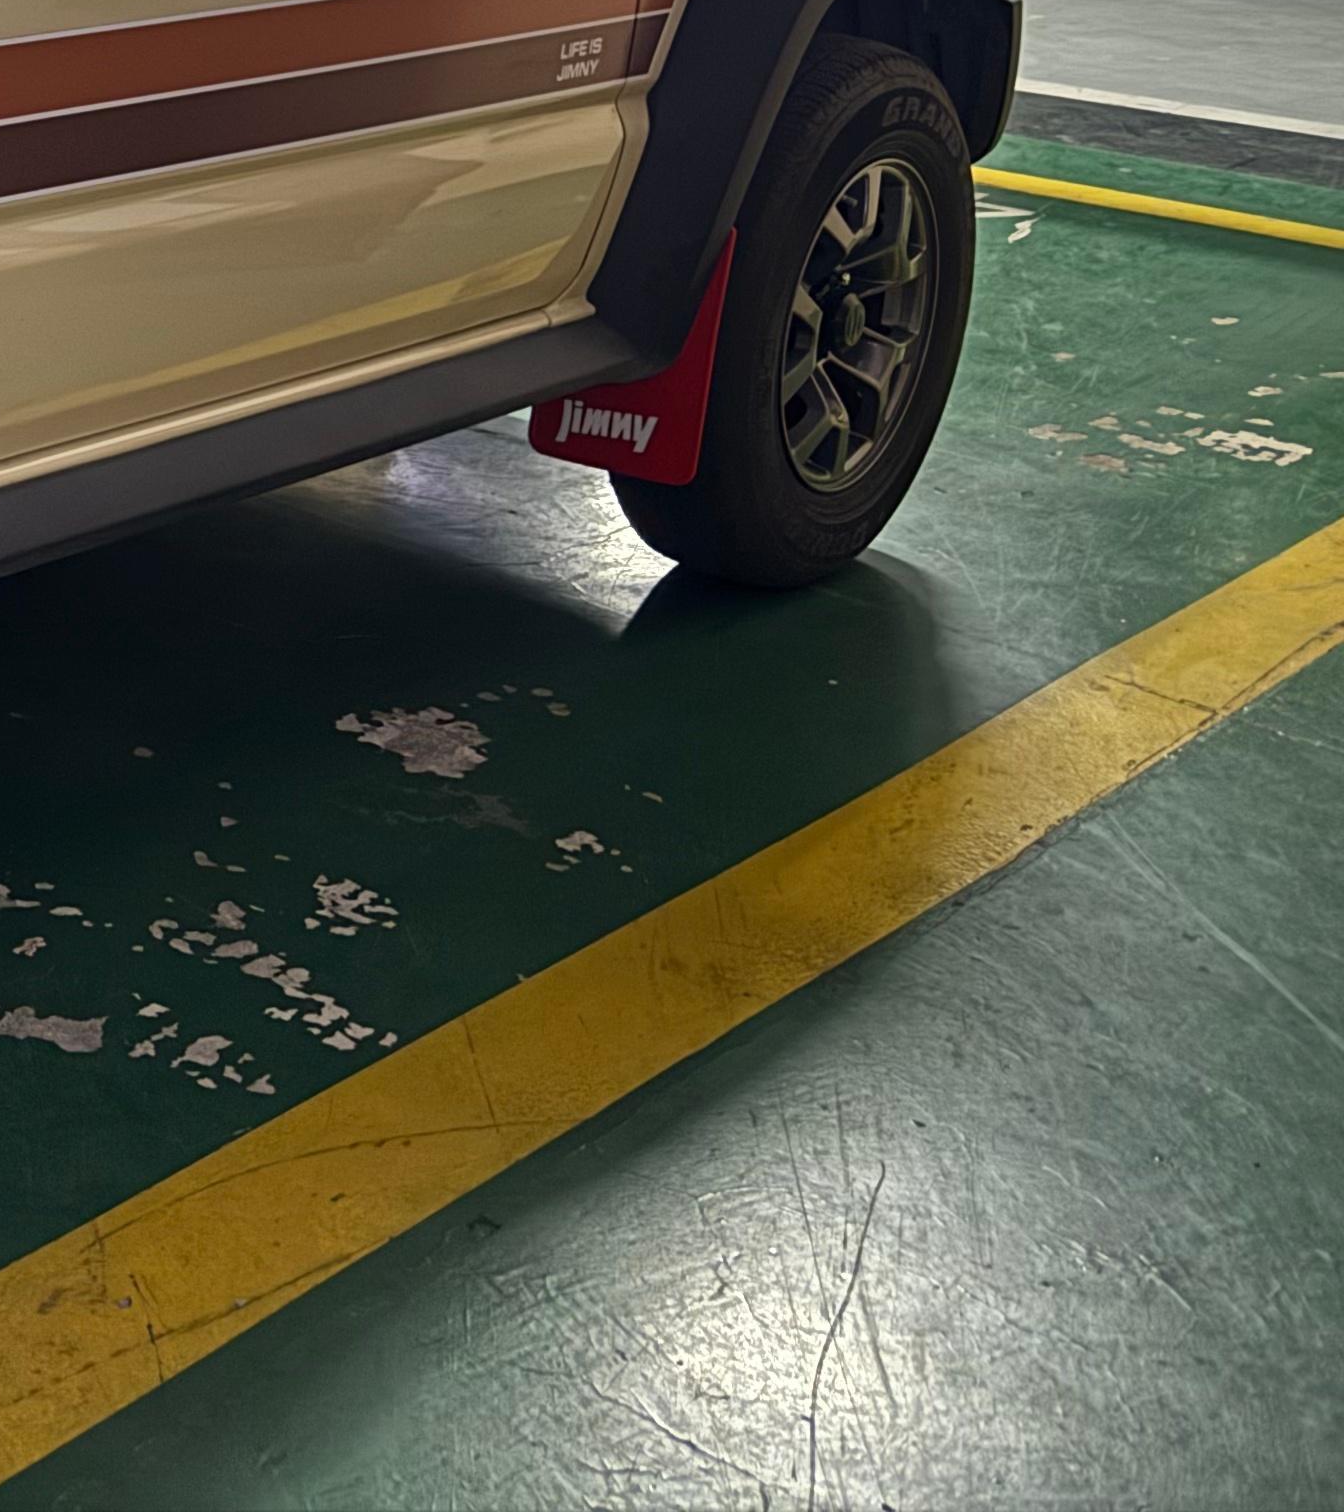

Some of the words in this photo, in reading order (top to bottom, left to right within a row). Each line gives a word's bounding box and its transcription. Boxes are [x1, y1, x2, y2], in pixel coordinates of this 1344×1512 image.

[560, 39, 589, 60] LIFE
[589, 37, 603, 55] IS
[556, 59, 600, 82] JIMNY
[555, 399, 658, 454] Jimny
